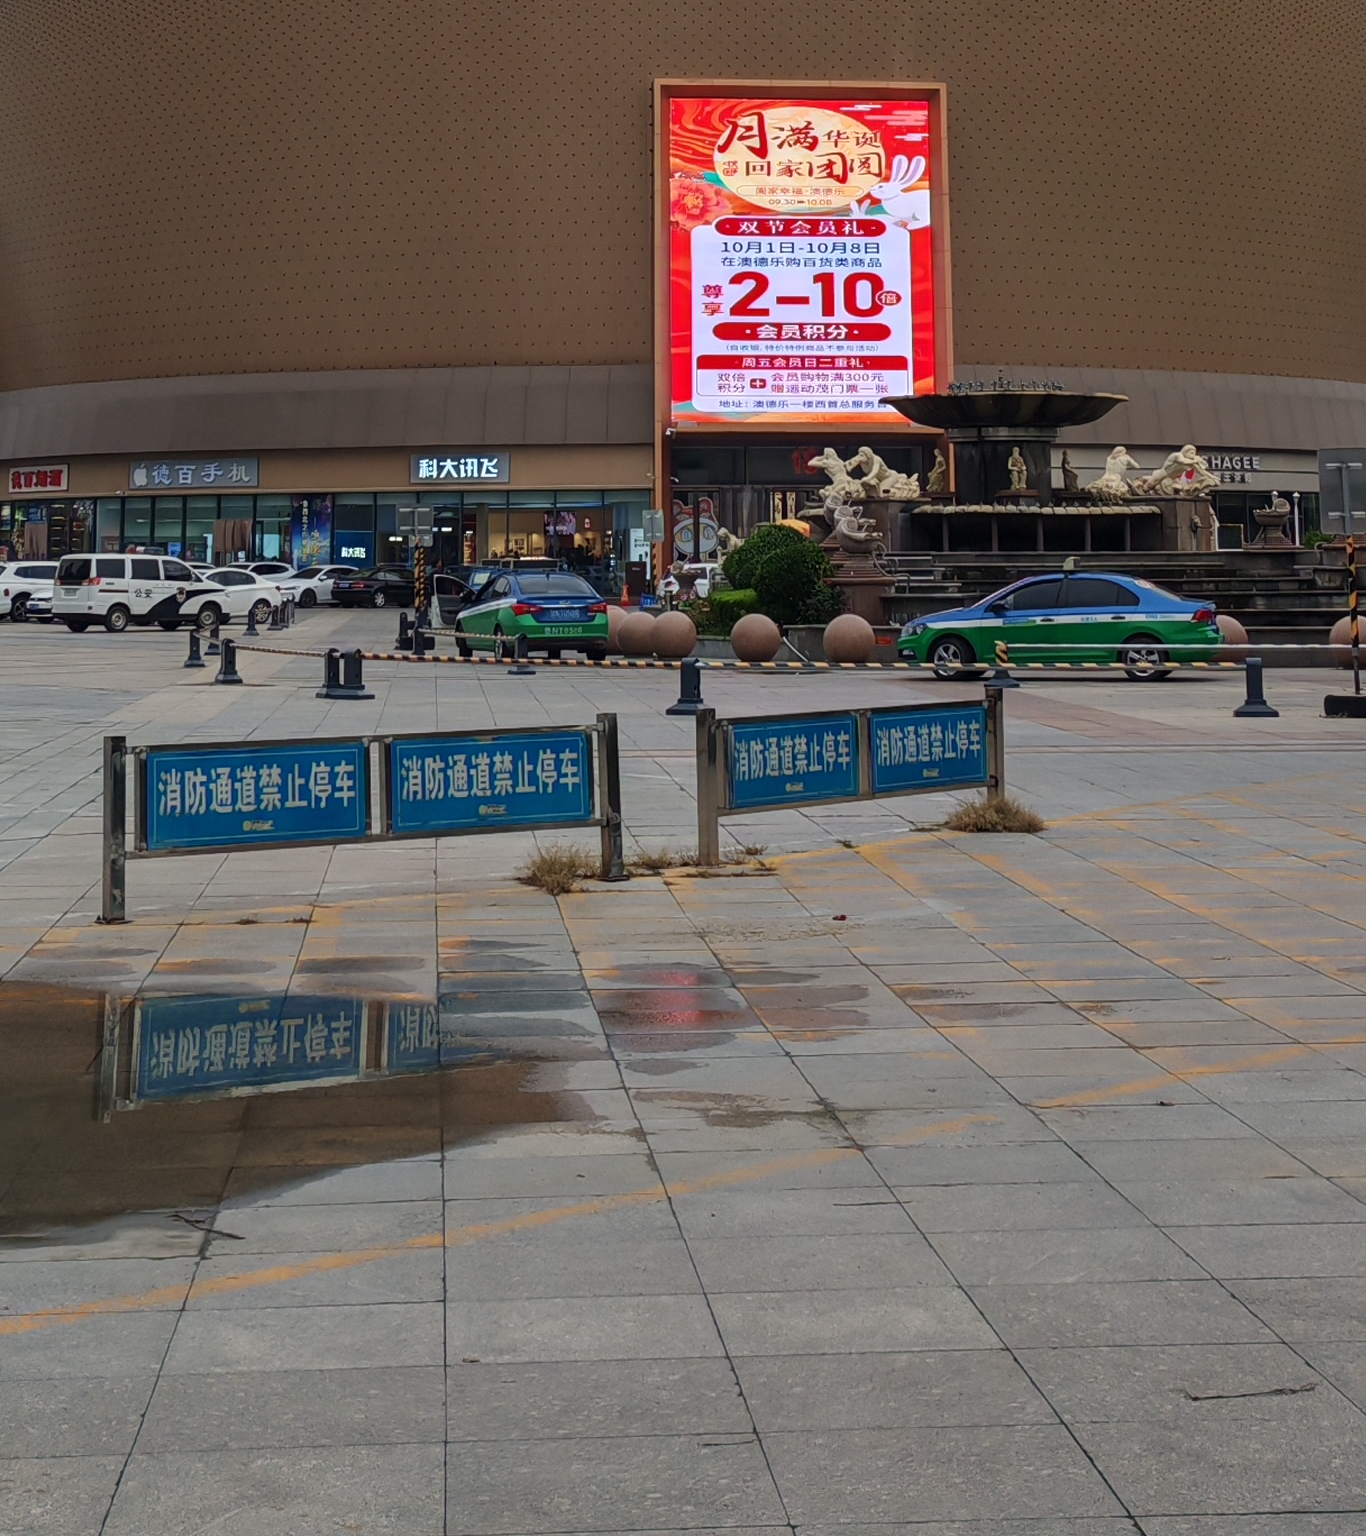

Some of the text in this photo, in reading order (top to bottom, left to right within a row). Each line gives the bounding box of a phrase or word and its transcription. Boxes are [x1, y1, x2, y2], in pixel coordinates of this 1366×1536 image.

[717, 111, 883, 160] 月满华诞
[745, 152, 883, 185] 回家团圆
[737, 220, 865, 236] 双节会员礼
[720, 241, 881, 255] 10月1日-10月8日
[720, 256, 883, 268] 在澳德乐购百货类商品
[756, 324, 849, 340] 会员积分
[741, 357, 864, 369] 周五会员日二重礼
[771, 372, 885, 382] 会员购物满300元
[151, 461, 252, 486] 德百手机
[418, 457, 500, 479] 科大讯飞
[876, 718, 982, 767] 消防通道禁止停车
[735, 729, 851, 782] 消防通道禁止停车
[401, 747, 581, 802] 消防通道禁止停车
[158, 759, 356, 817] 消防通道禁止停车
